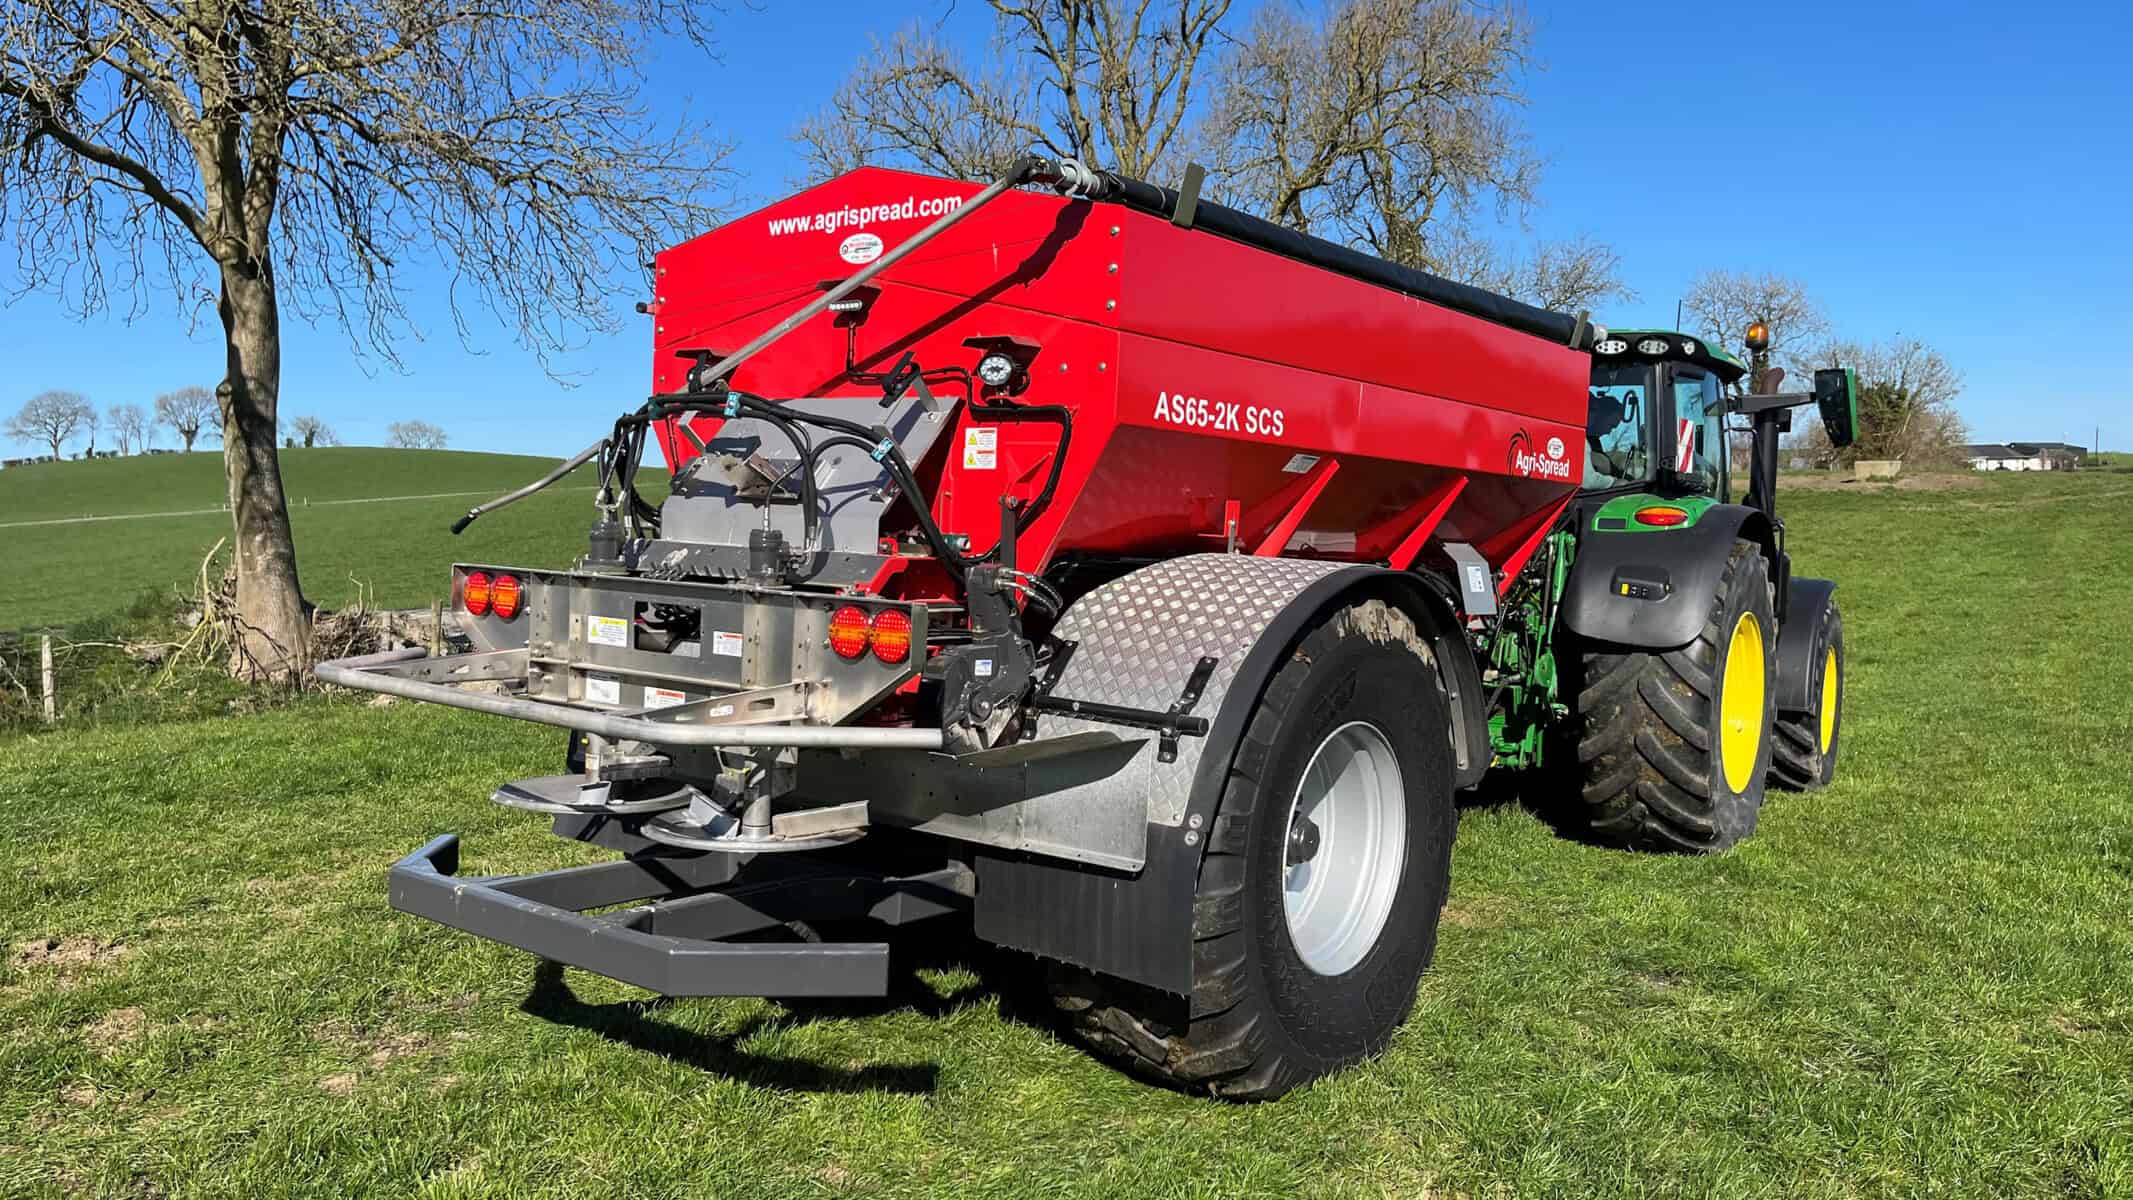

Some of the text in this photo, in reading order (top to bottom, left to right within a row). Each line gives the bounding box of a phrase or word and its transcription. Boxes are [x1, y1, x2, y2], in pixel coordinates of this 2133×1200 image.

[769, 195, 962, 236] www.agrispread.com
[1153, 391, 1284, 437] AS65-2K SCS
[1515, 449, 1570, 479] Agri-Spread
